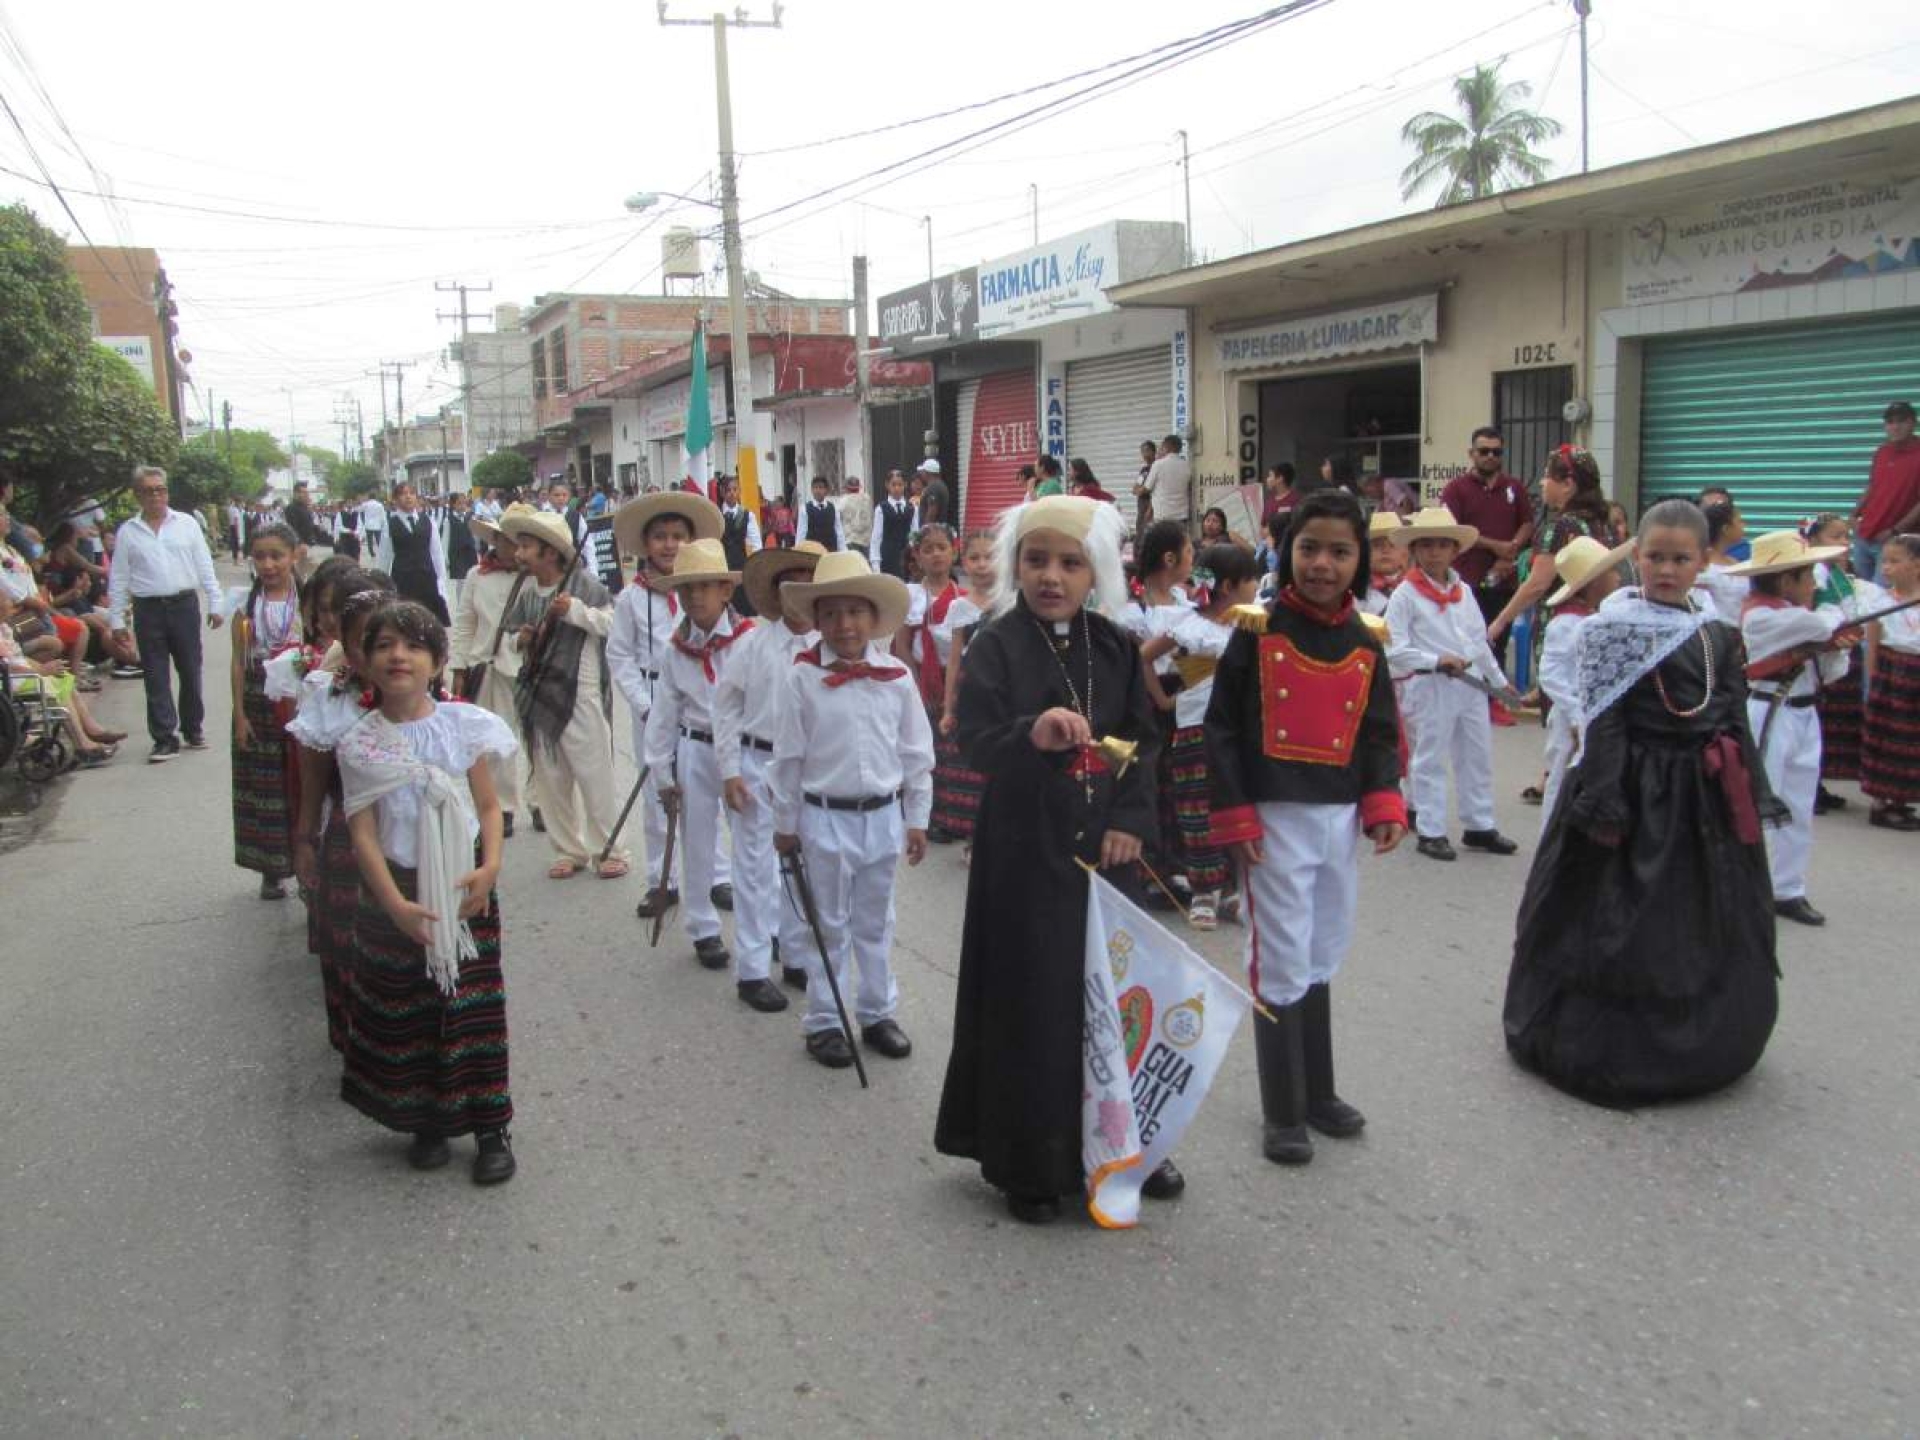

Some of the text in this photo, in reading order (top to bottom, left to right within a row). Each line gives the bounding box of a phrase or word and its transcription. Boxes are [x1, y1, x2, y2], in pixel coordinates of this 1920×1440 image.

[1698, 213, 1878, 259] VANGUARDIA
[981, 253, 1061, 308] FARMACIA
[1222, 313, 1399, 361] PAPELERIA LUMACAR
[1144, 1042, 1194, 1096] GUA
